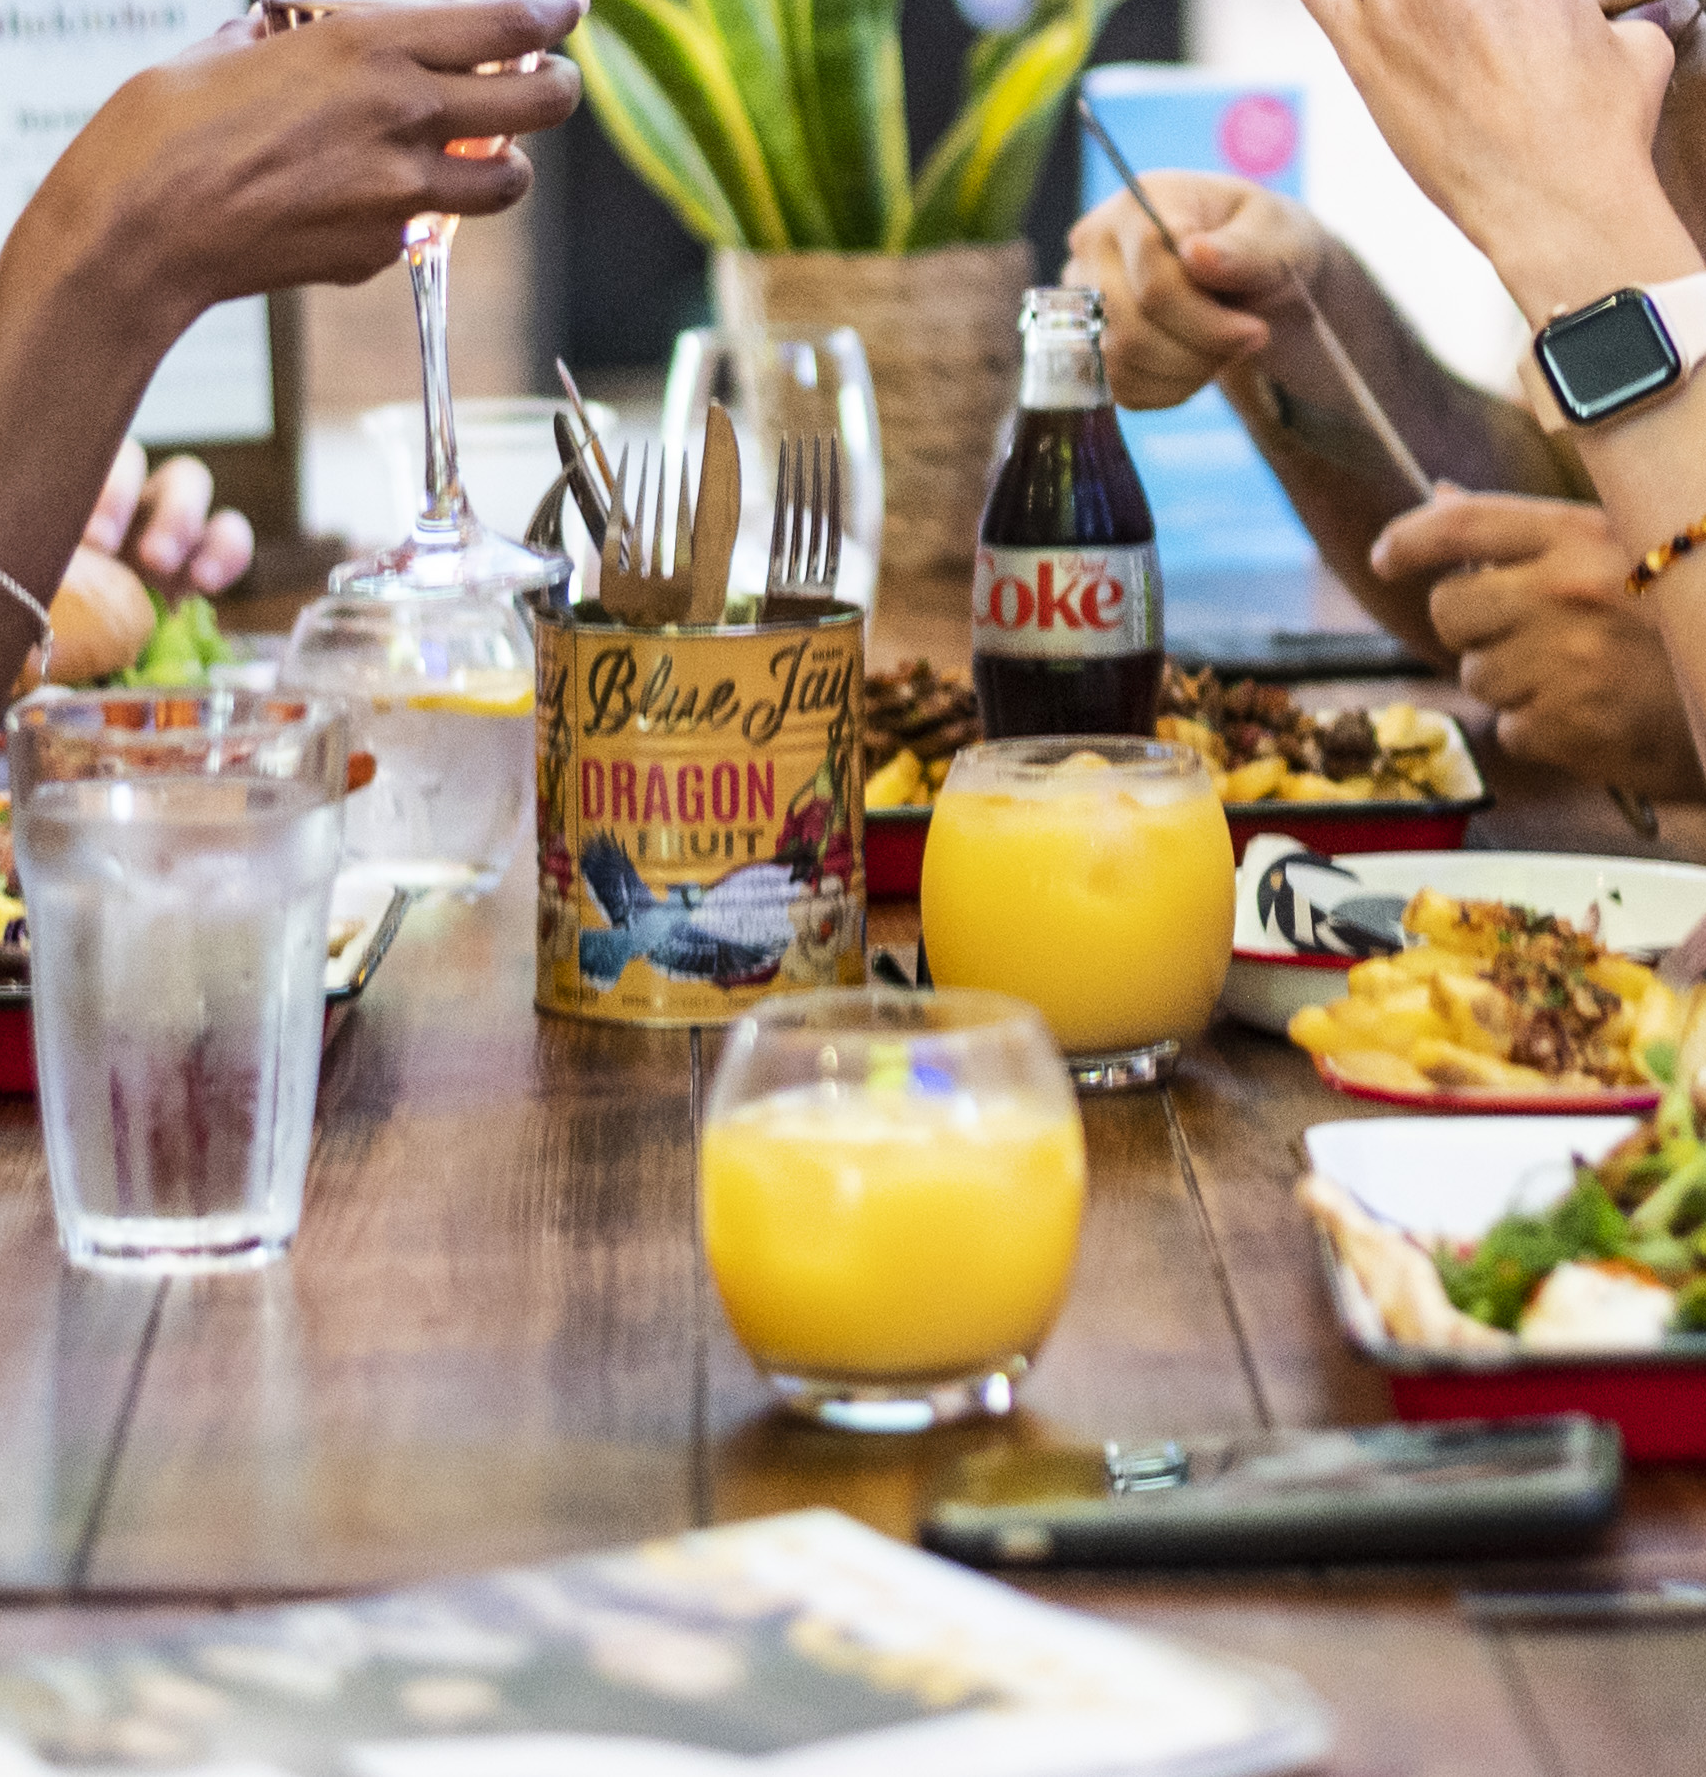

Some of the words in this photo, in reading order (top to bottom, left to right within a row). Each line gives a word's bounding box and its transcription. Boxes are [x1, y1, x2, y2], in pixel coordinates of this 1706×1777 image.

[584, 645, 741, 737] Blue
[742, 638, 854, 745] Jay
[580, 757, 776, 827] DRAGON
[637, 827, 765, 861] UIT
